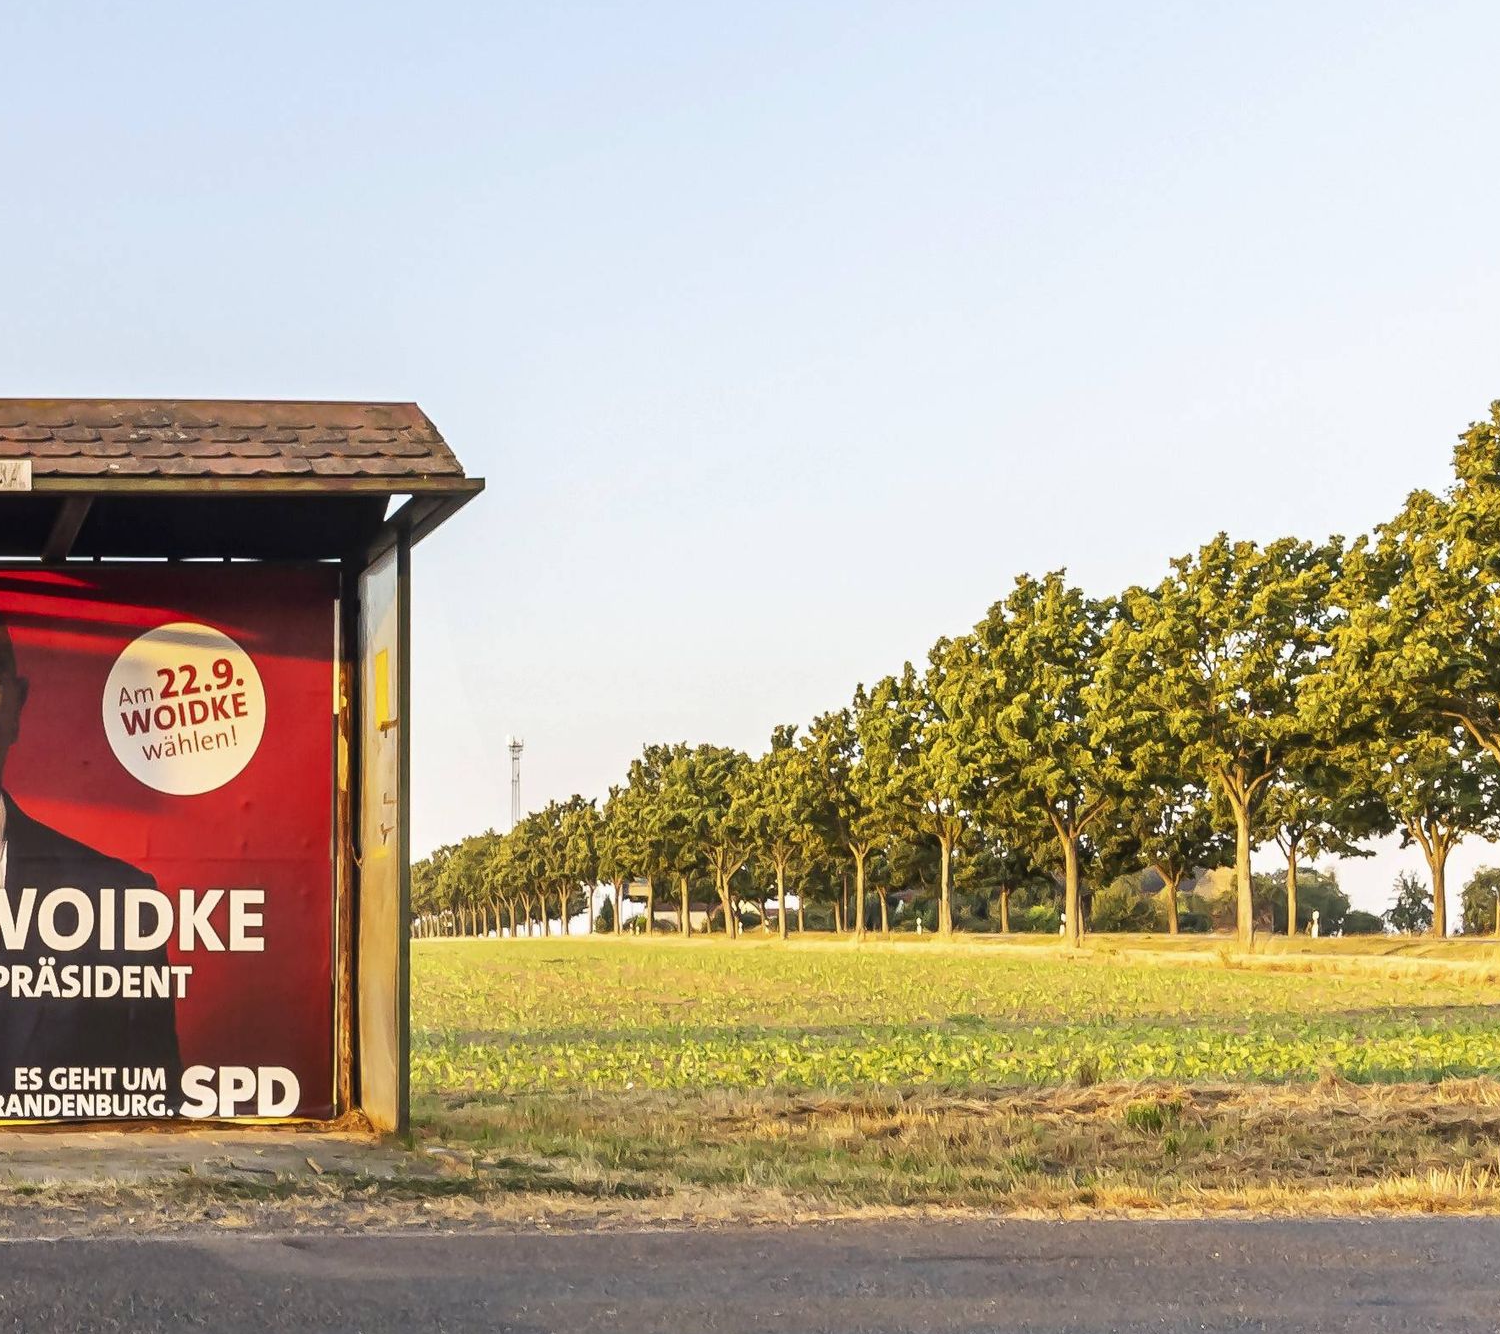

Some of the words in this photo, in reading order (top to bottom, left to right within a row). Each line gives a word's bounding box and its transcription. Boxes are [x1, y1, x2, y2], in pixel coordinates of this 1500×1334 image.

[119, 686, 154, 707] Am
[156, 658, 245, 699] 22.9.
[120, 692, 248, 737] WOIDKE
[142, 725, 238, 761] wählen!
[14, 1067, 43, 1091] ES
[48, 1067, 117, 1091] GEHT
[122, 1067, 167, 1091] UM
[179, 1064, 300, 1119] SPD
